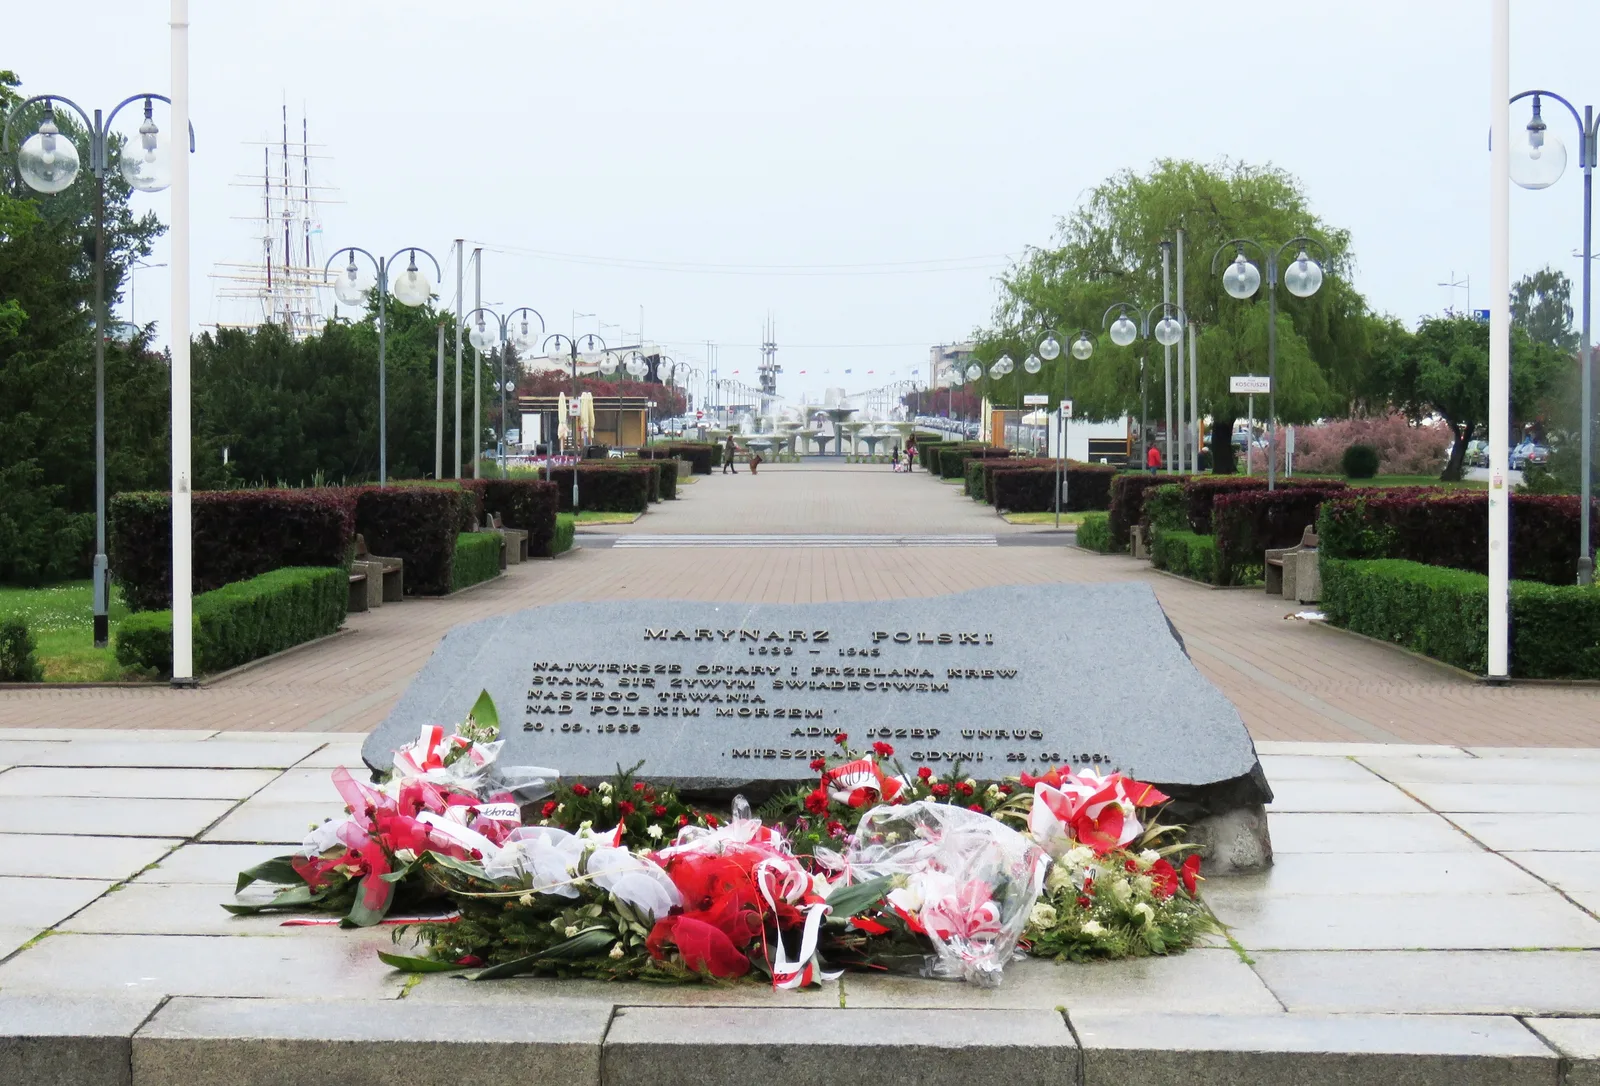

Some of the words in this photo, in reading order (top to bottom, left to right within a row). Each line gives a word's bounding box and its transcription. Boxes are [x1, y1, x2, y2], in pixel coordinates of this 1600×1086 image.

[643, 629, 830, 644] MARYNARZ
[871, 631, 994, 646] POLSKI
[748, 646, 793, 657] 1939
[839, 647, 881, 658] 1945
[696, 664, 781, 677] OFIARY
[790, 666, 798, 677] I
[811, 666, 934, 679] PRZELANA
[947, 668, 1018, 680] KREW
[527, 690, 640, 702] NASZEGO
[657, 692, 766, 705] TRWANIA
[525, 704, 573, 715] NAD
[590, 705, 700, 718] POLSKIM
[790, 727, 842, 738] ADM
[960, 729, 1044, 741] UNRUG
